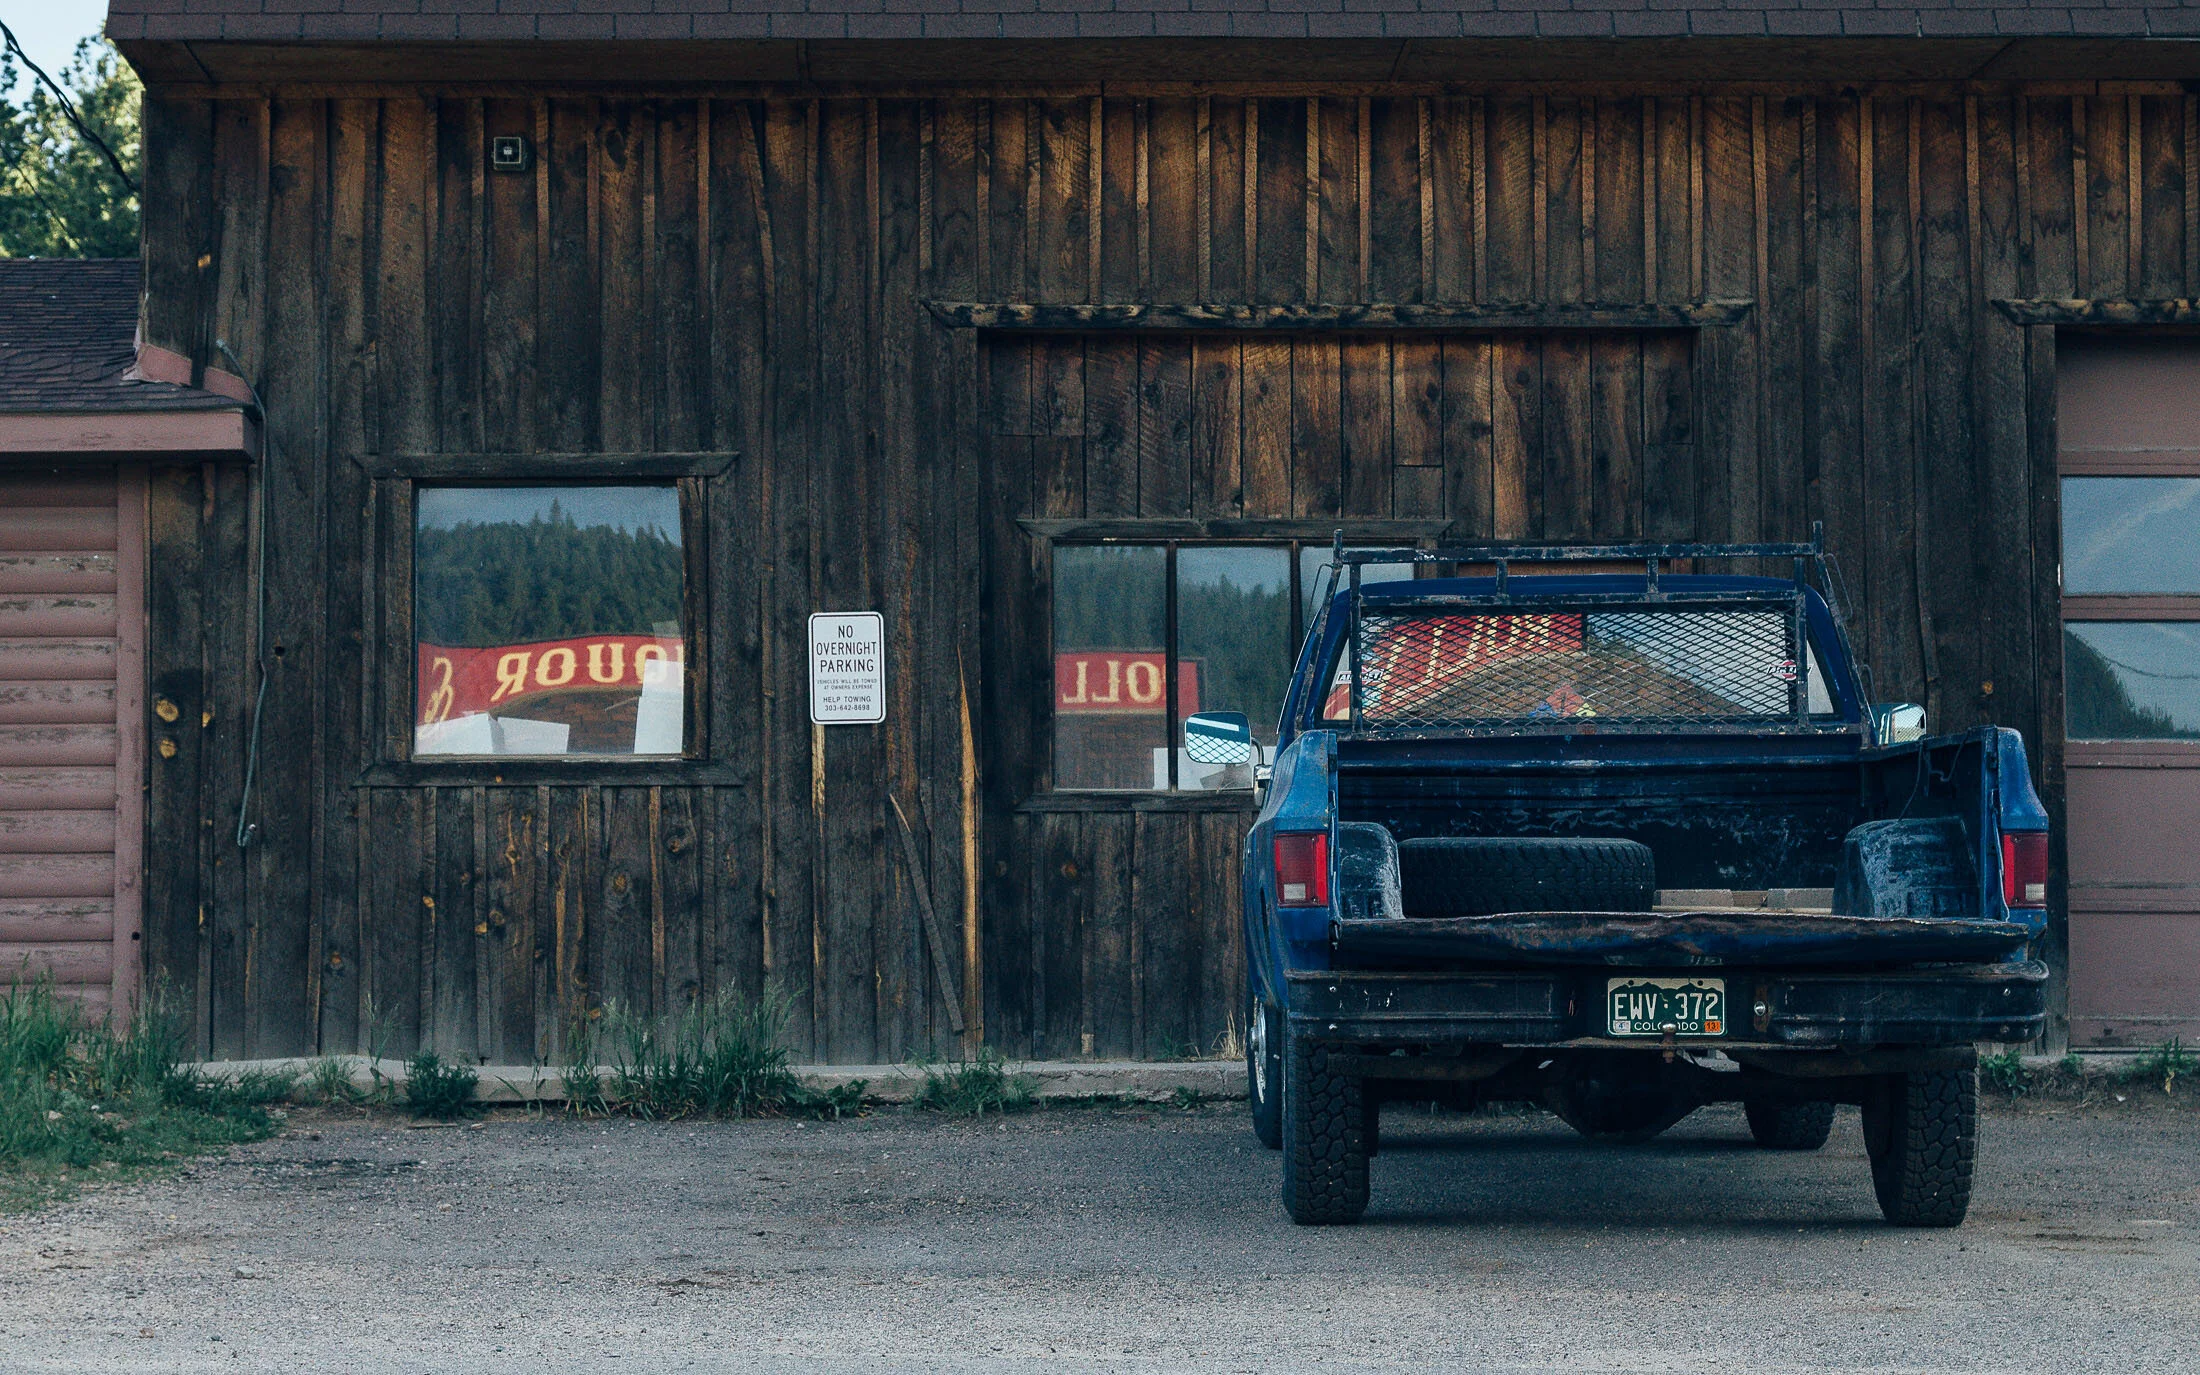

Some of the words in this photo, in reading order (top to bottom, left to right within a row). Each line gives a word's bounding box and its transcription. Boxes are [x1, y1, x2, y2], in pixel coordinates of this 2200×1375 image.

[838, 625, 853, 638] NO
[816, 641, 877, 656] OVERNIGHT
[820, 659, 874, 673] PARKING
[844, 695, 872, 703] TOWING
[1633, 1021, 1699, 1031] COLDO
